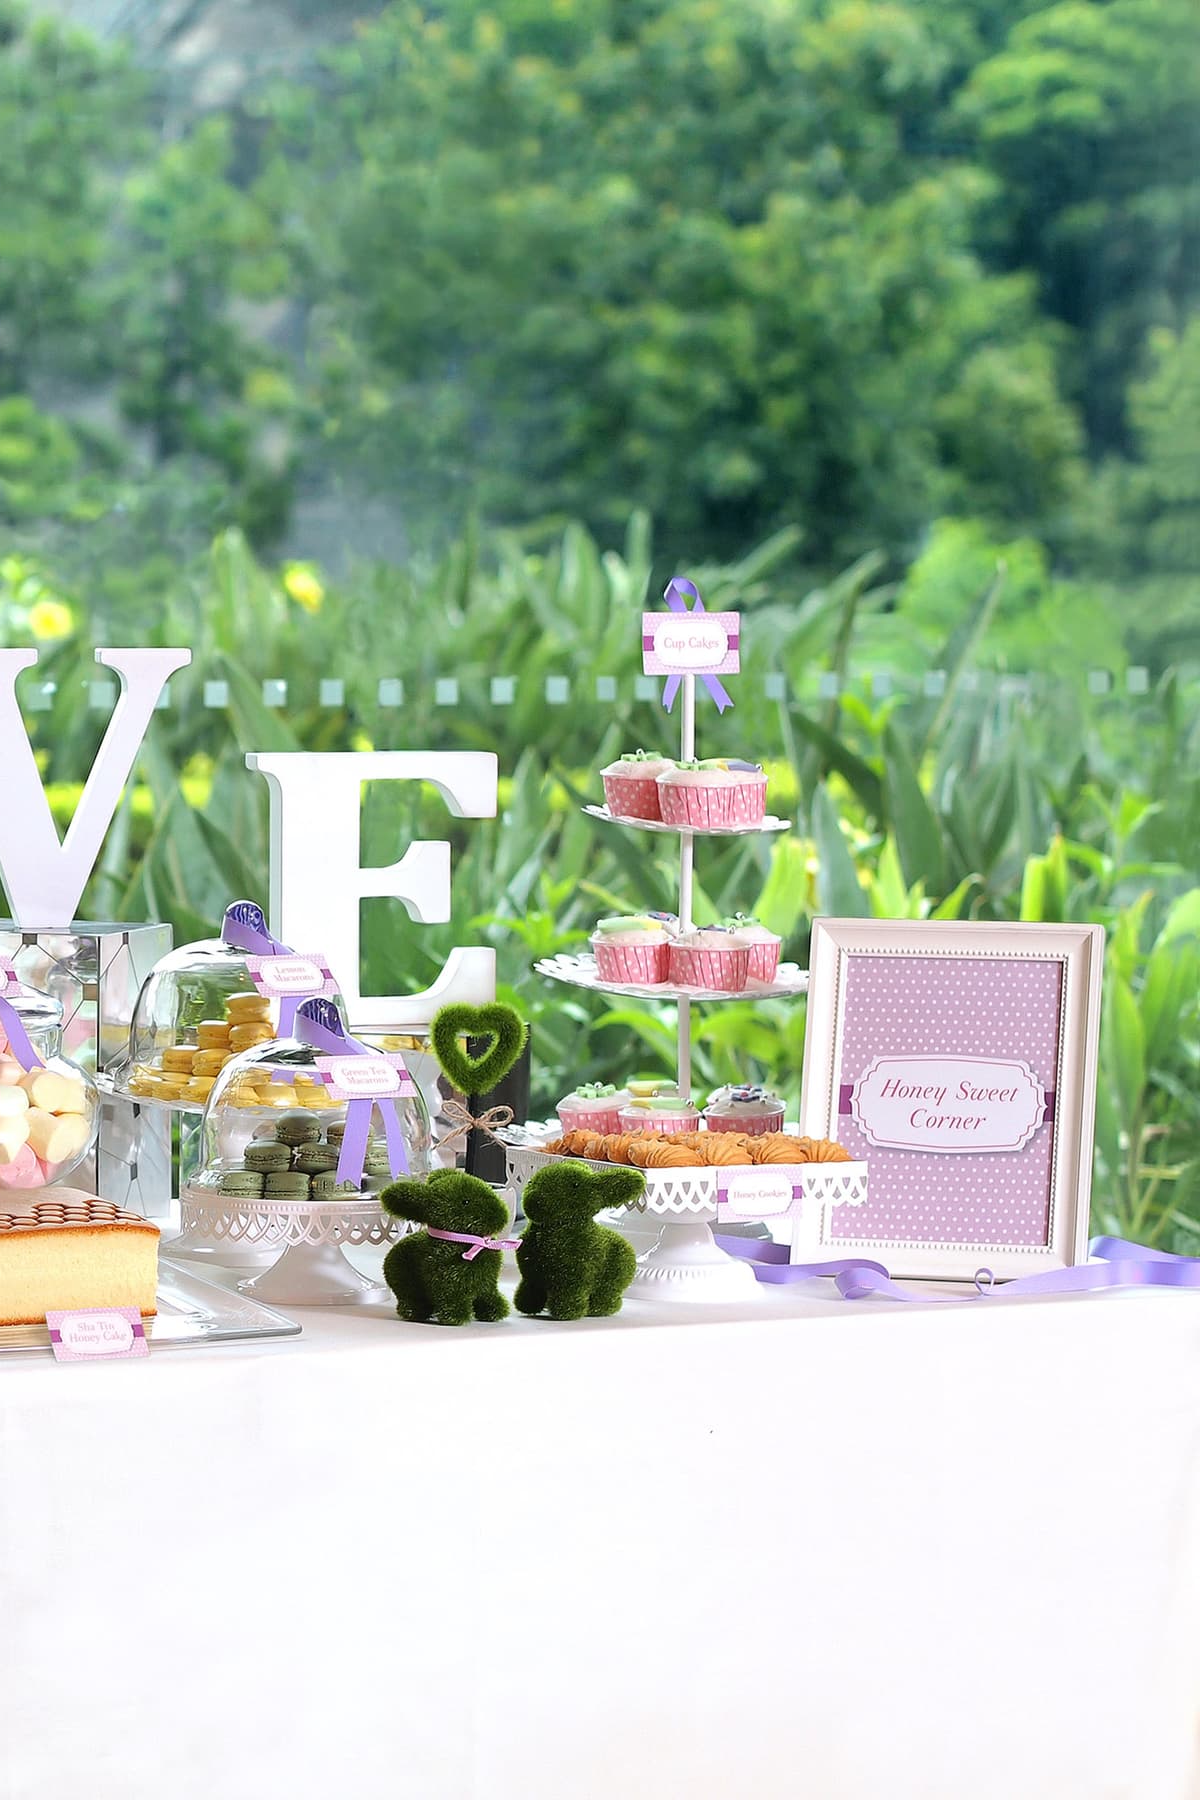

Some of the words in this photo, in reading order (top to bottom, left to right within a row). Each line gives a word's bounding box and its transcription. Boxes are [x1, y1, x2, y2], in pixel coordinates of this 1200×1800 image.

[663, 636, 686, 652] Cup
[688, 636, 720, 650] Cakes
[274, 966, 306, 974] Lemon
[273, 974, 315, 982] Macarons
[340, 1067, 368, 1077] Green
[368, 1066, 387, 1075] Tea
[346, 1076, 389, 1085] Macarons
[879, 1079, 948, 1106] Honey
[955, 1080, 1019, 1102] Sweet
[909, 1108, 987, 1130] Corner
[733, 1191, 756, 1200] Honey
[758, 1189, 788, 1198] Cookies
[76, 1322, 95, 1332] Sha
[96, 1321, 115, 1331] Tin
[69, 1333, 101, 1344] Honey
[103, 1331, 127, 1341] Cake
